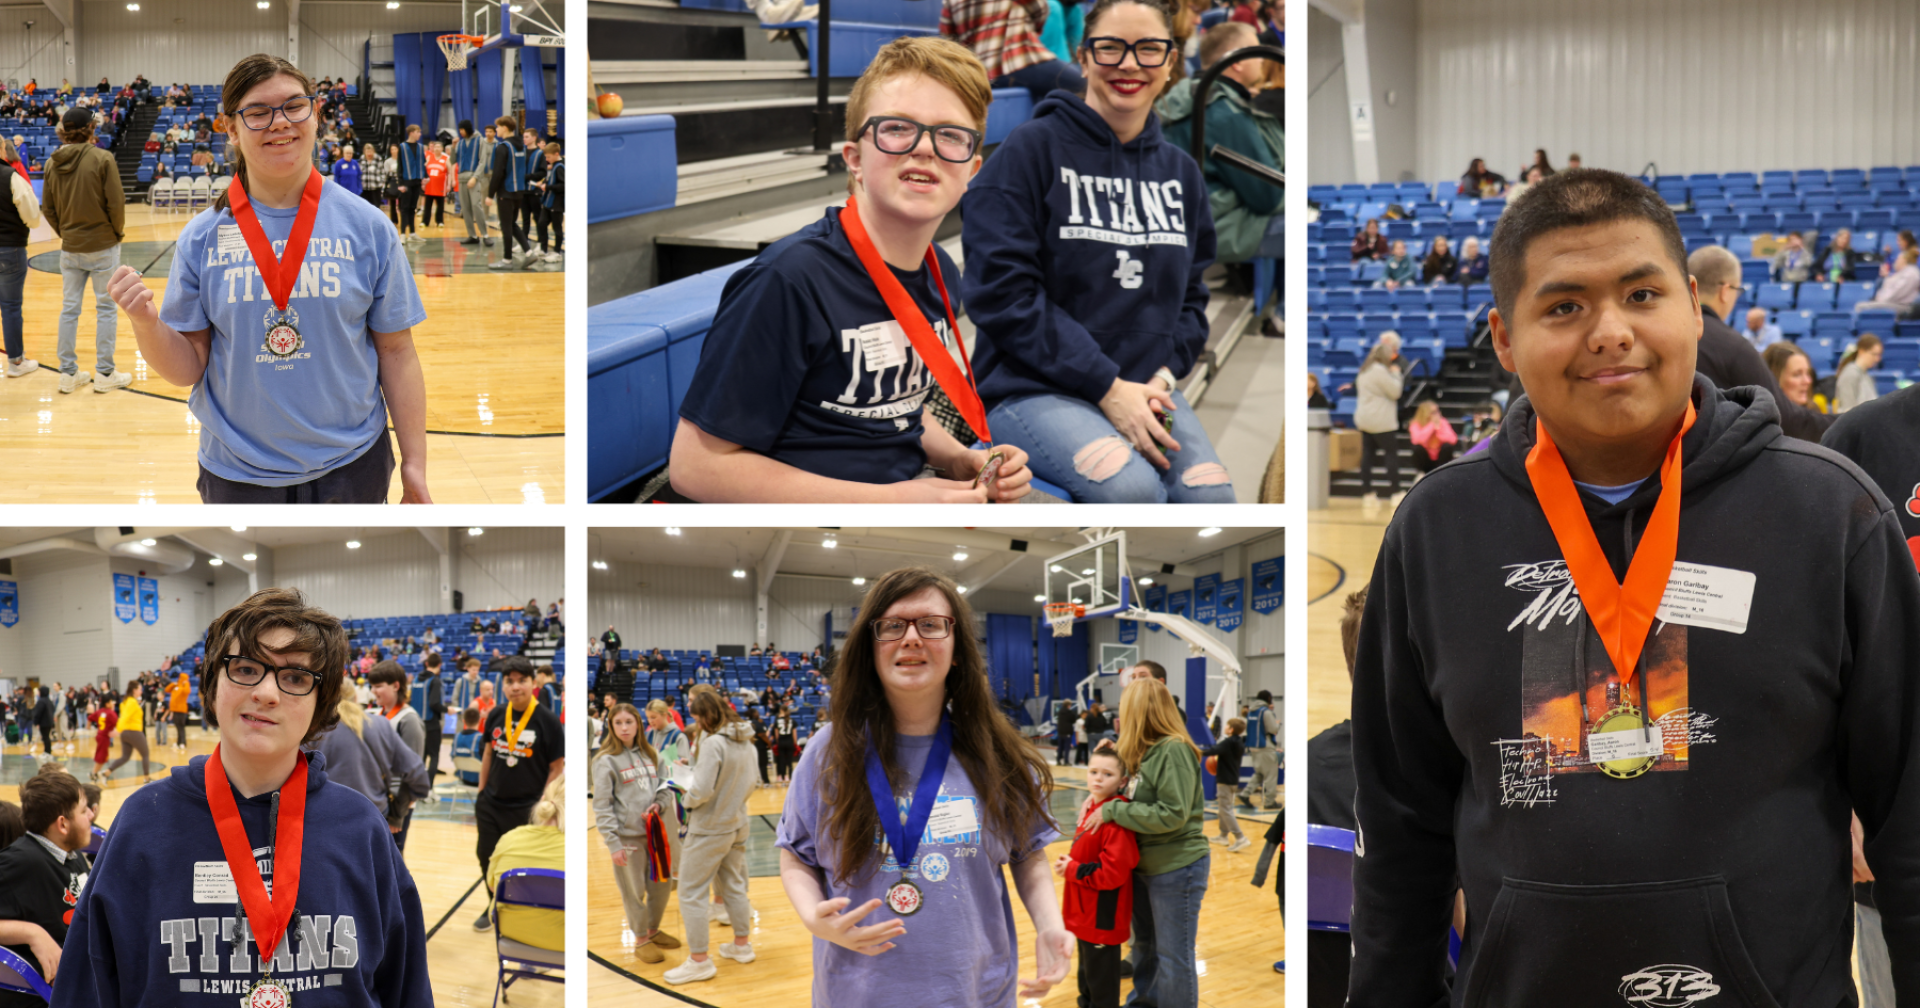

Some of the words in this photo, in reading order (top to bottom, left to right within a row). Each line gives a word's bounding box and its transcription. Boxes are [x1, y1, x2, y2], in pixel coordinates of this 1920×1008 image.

[1060, 166, 1186, 232] TITANS
[1067, 229, 1122, 243] SPECIAL
[206, 246, 254, 267] LEWI
[271, 237, 355, 262] CTRAL
[1112, 250, 1143, 289] LC
[1255, 598, 1279, 610] 2013
[1197, 609, 1217, 620] 2012
[1219, 616, 1241, 628] 2013
[953, 847, 978, 858] 2019
[203, 979, 250, 994] LEWIS
[1621, 972, 1721, 1001] 313
